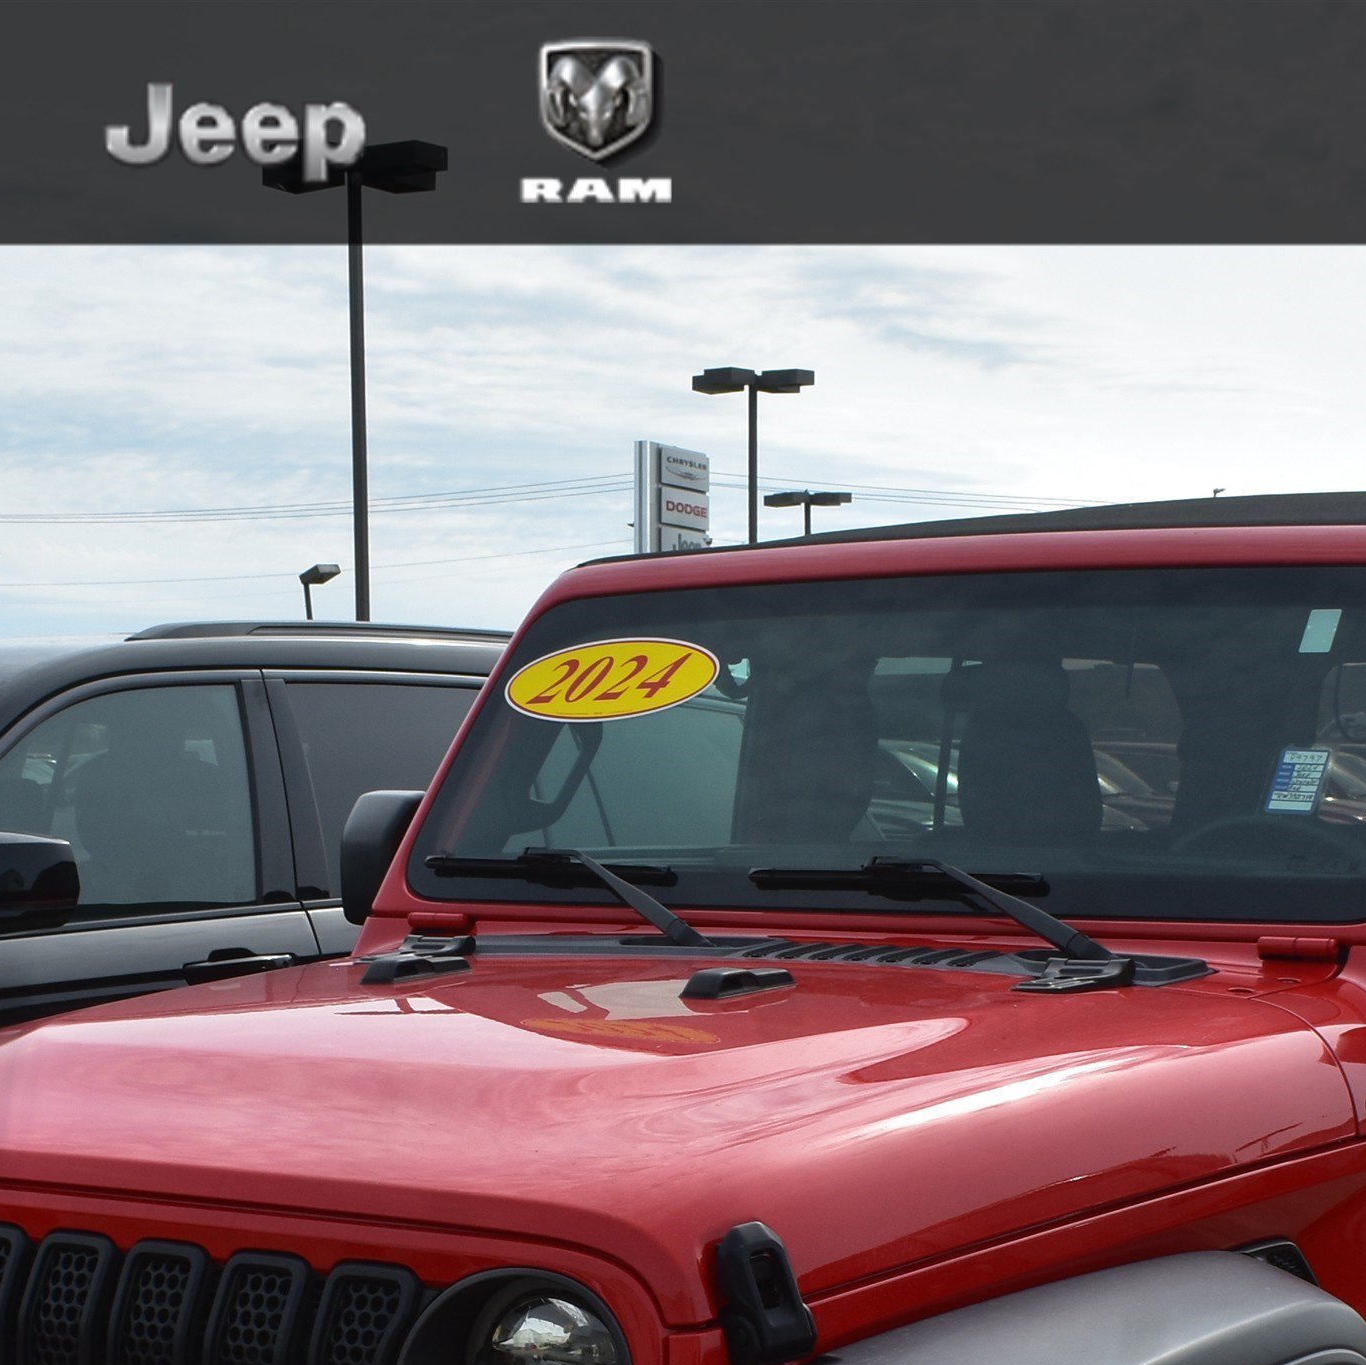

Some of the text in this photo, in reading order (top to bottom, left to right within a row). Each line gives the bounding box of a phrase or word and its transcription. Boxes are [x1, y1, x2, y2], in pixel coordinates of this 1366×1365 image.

[666, 456, 707, 470] CHRYSLER
[666, 500, 707, 518] DODGE
[525, 652, 693, 704] 2024
